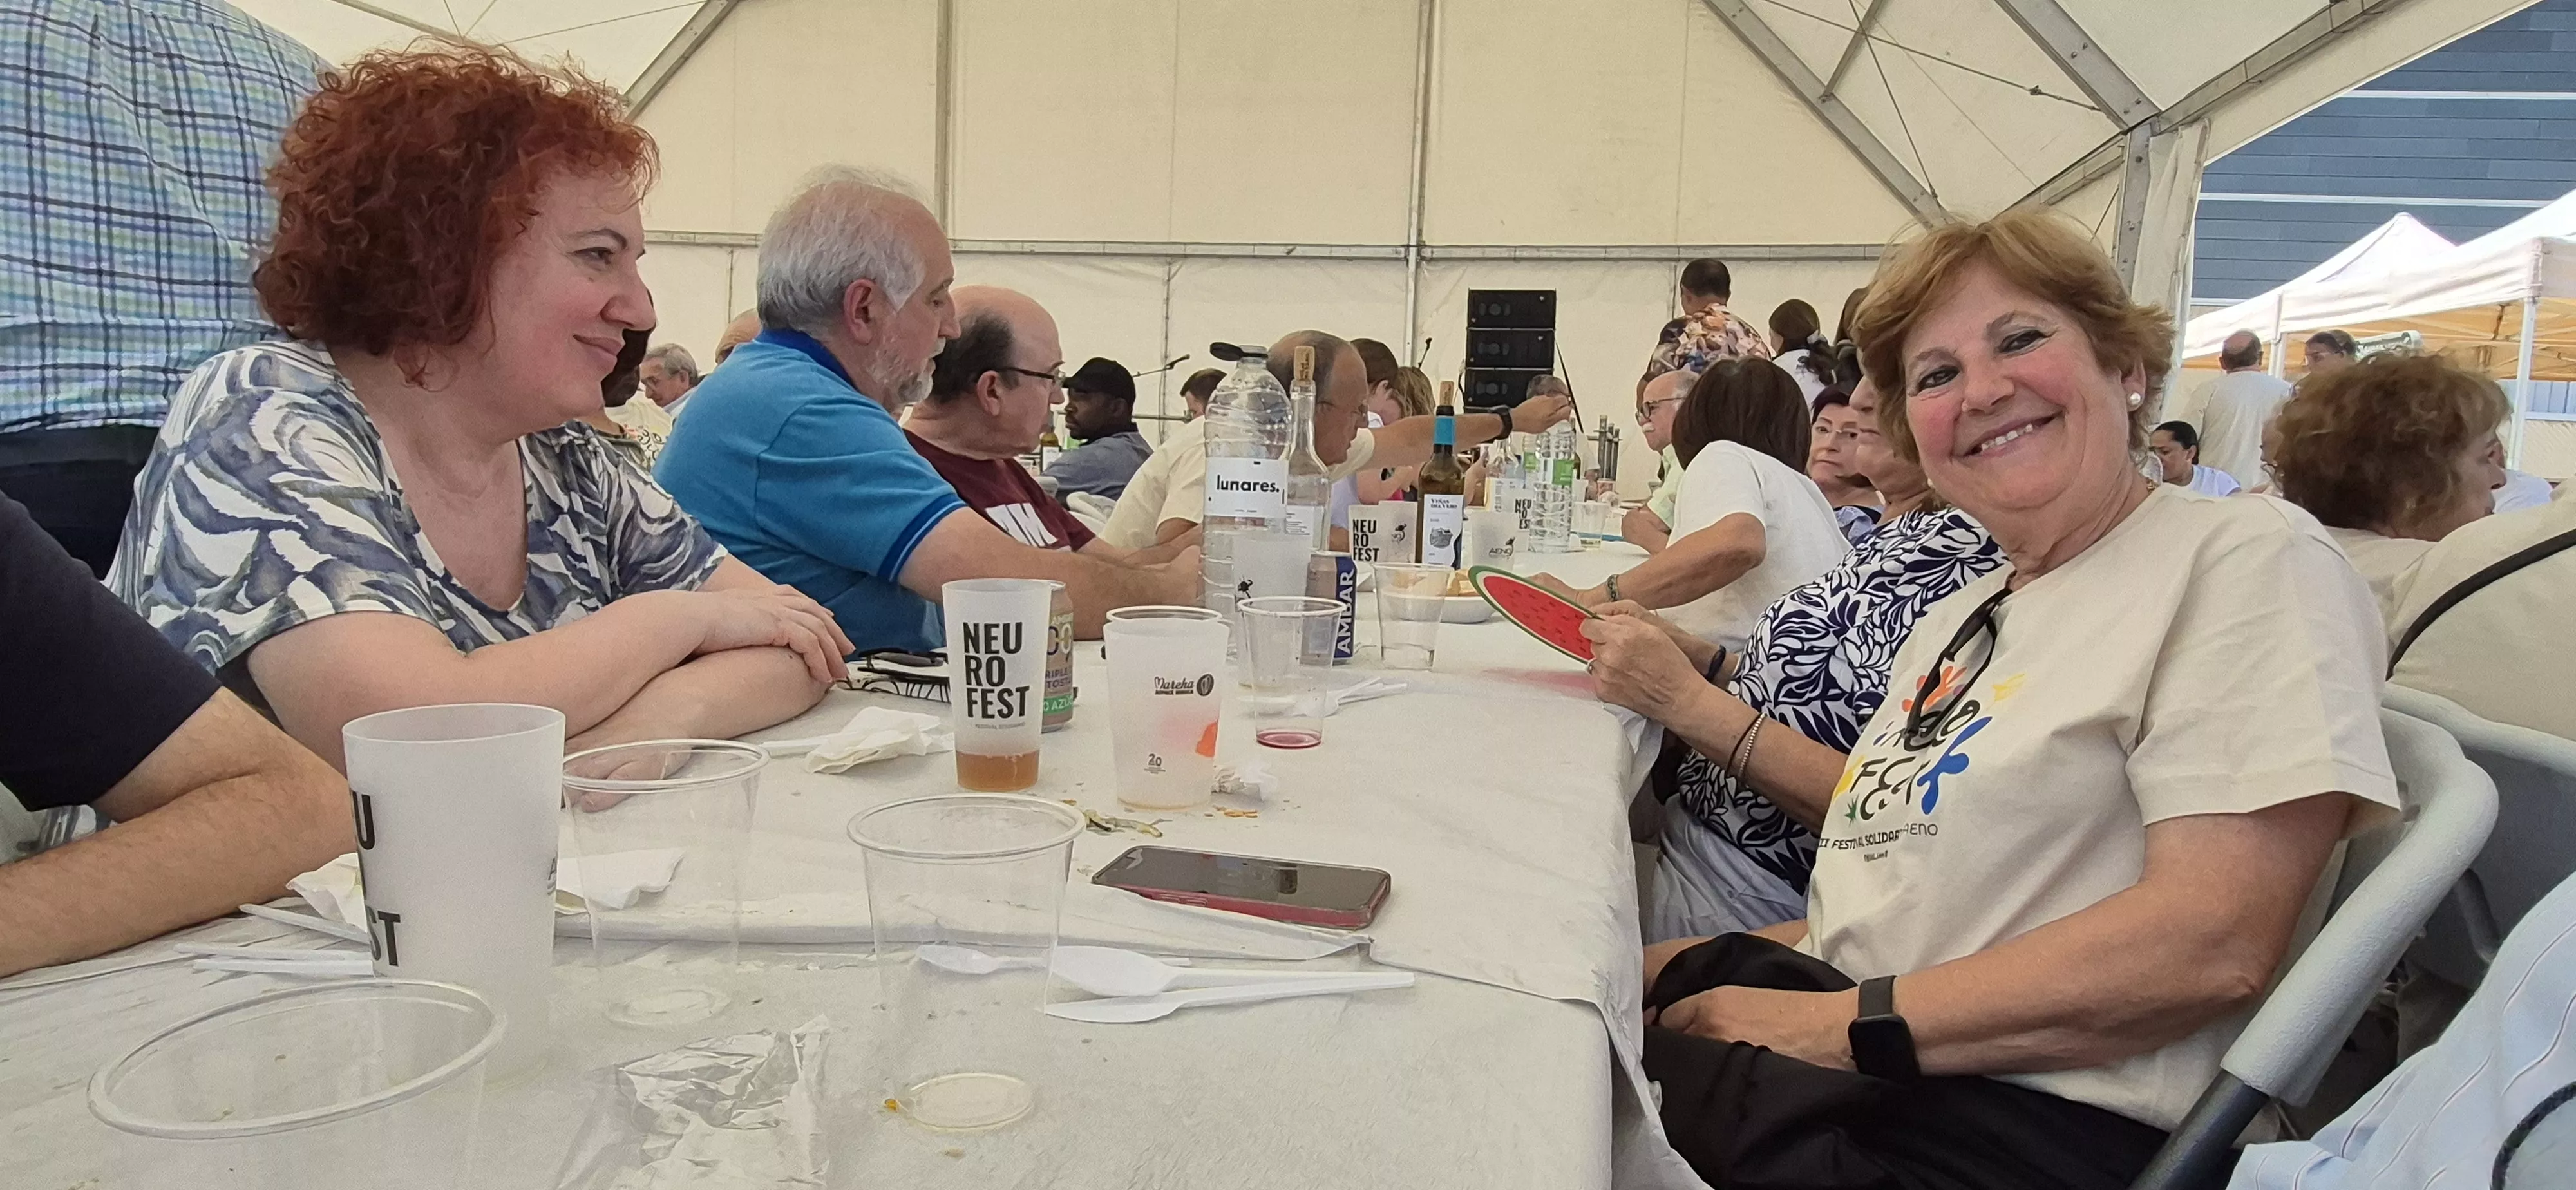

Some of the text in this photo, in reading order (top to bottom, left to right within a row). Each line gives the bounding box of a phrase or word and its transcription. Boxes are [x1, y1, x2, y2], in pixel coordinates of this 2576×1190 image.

[1217, 474, 1280, 493] lunares.
[1515, 498, 1532, 513] NEU
[1352, 519, 1377, 534] NEU
[1519, 519, 1531, 529] EST
[1353, 533, 1369, 547] RO
[1353, 547, 1379, 562] FEST
[963, 621, 1023, 655] NEU
[965, 655, 1006, 687] RO
[966, 685, 1030, 719] FEST
